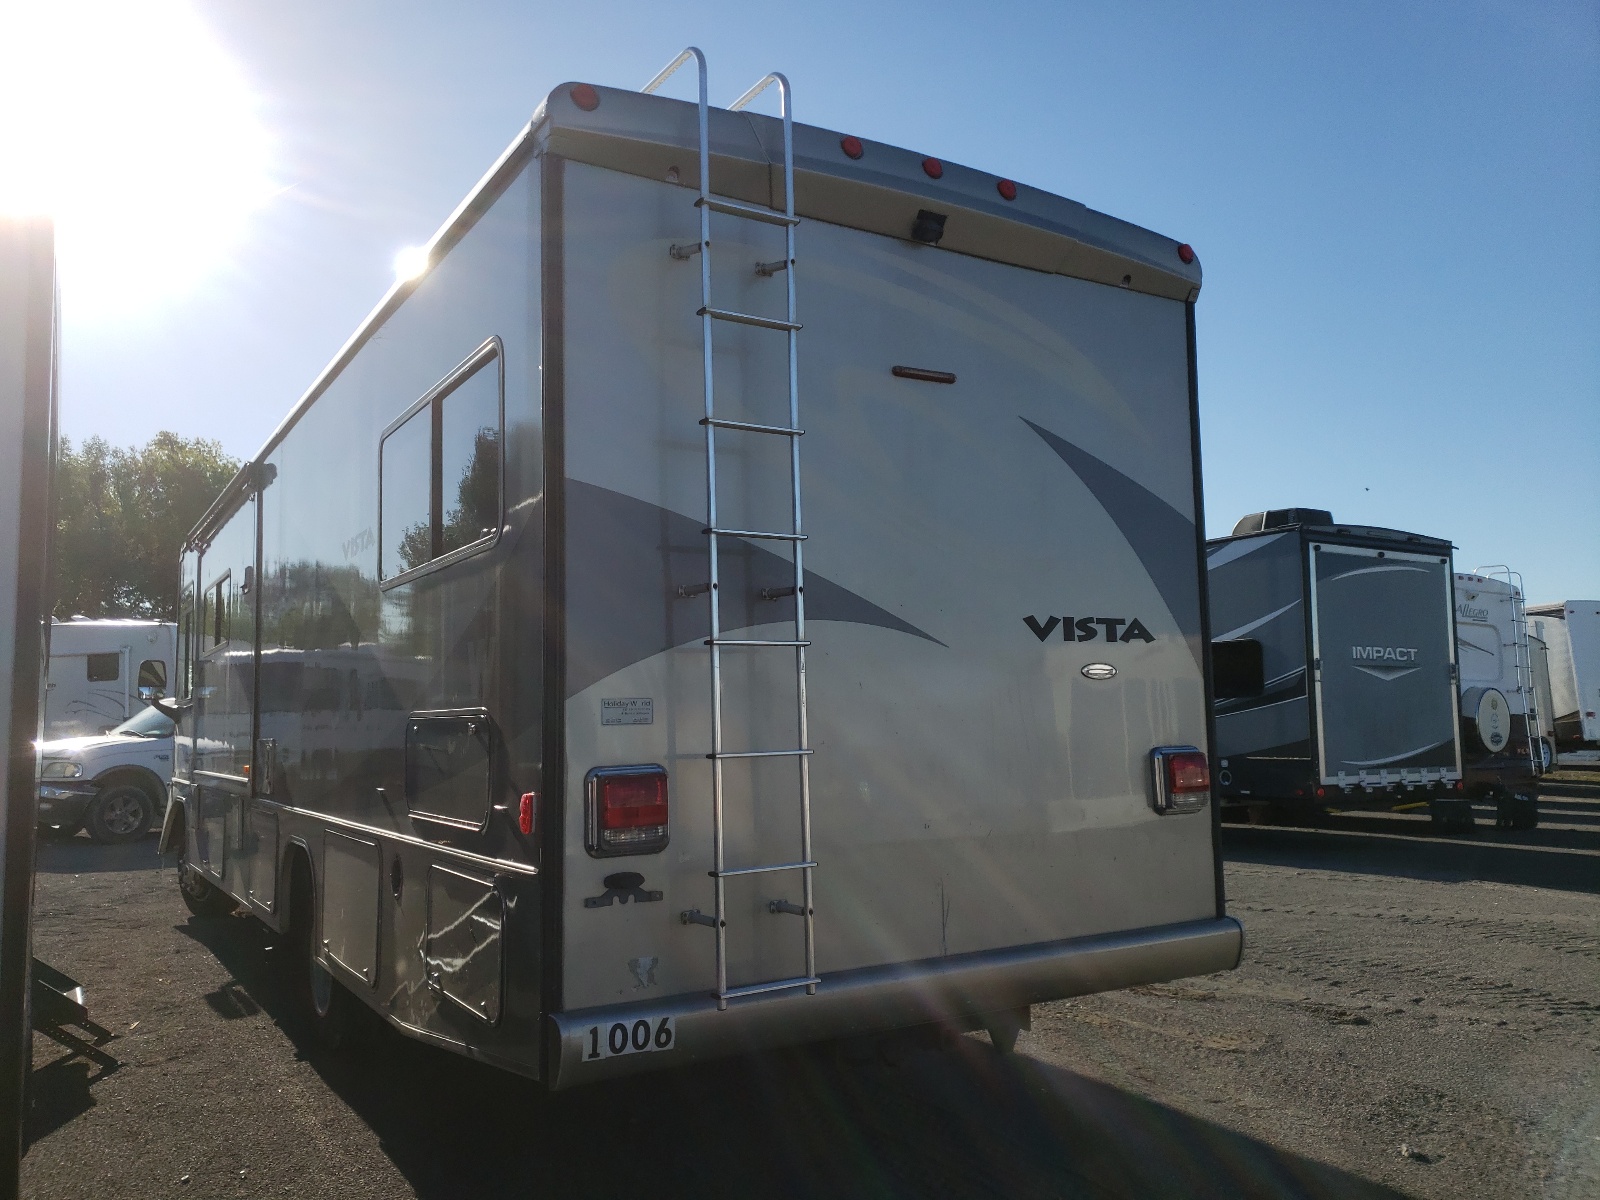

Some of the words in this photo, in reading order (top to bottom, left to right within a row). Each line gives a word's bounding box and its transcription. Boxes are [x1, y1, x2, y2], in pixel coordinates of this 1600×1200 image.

[341, 526, 375, 560] VISTA
[1023, 615, 1156, 643] VISTA
[1352, 646, 1418, 661] IMPACT
[588, 1017, 672, 1060] 1006
